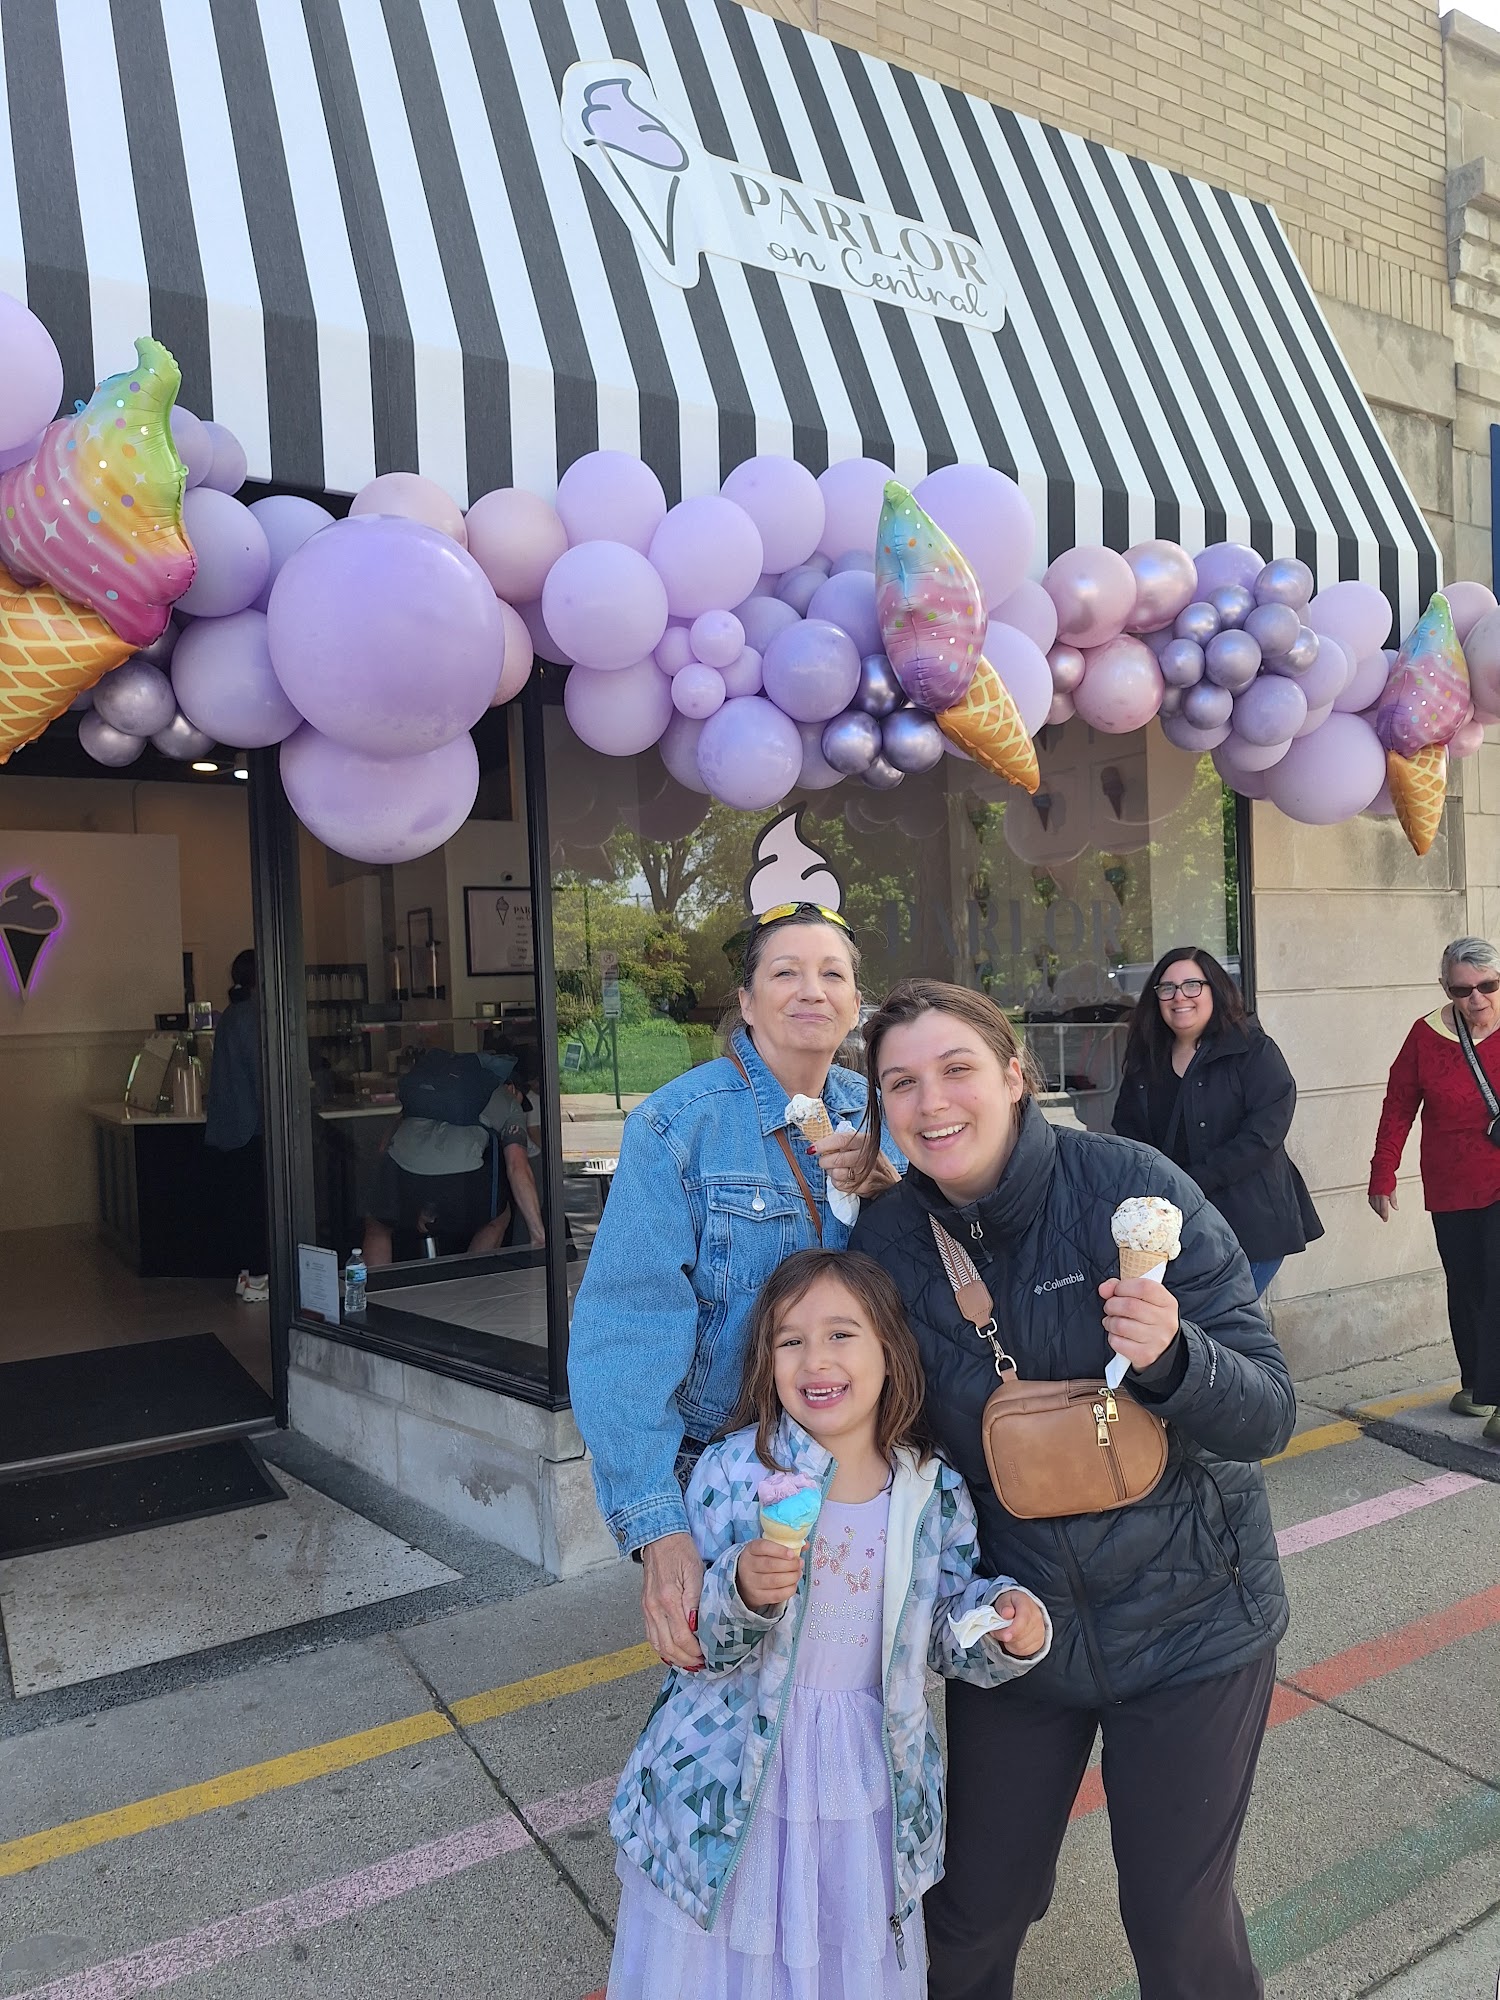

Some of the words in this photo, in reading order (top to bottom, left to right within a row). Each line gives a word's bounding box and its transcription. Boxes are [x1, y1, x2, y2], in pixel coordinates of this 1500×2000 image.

[729, 171, 987, 286] PARLOR
[767, 239, 826, 273] on
[840, 246, 988, 318] Central
[886, 899, 1124, 957] PARLOR
[1043, 1269, 1085, 1291] Columbia
[808, 1618, 859, 1644] Bestie
